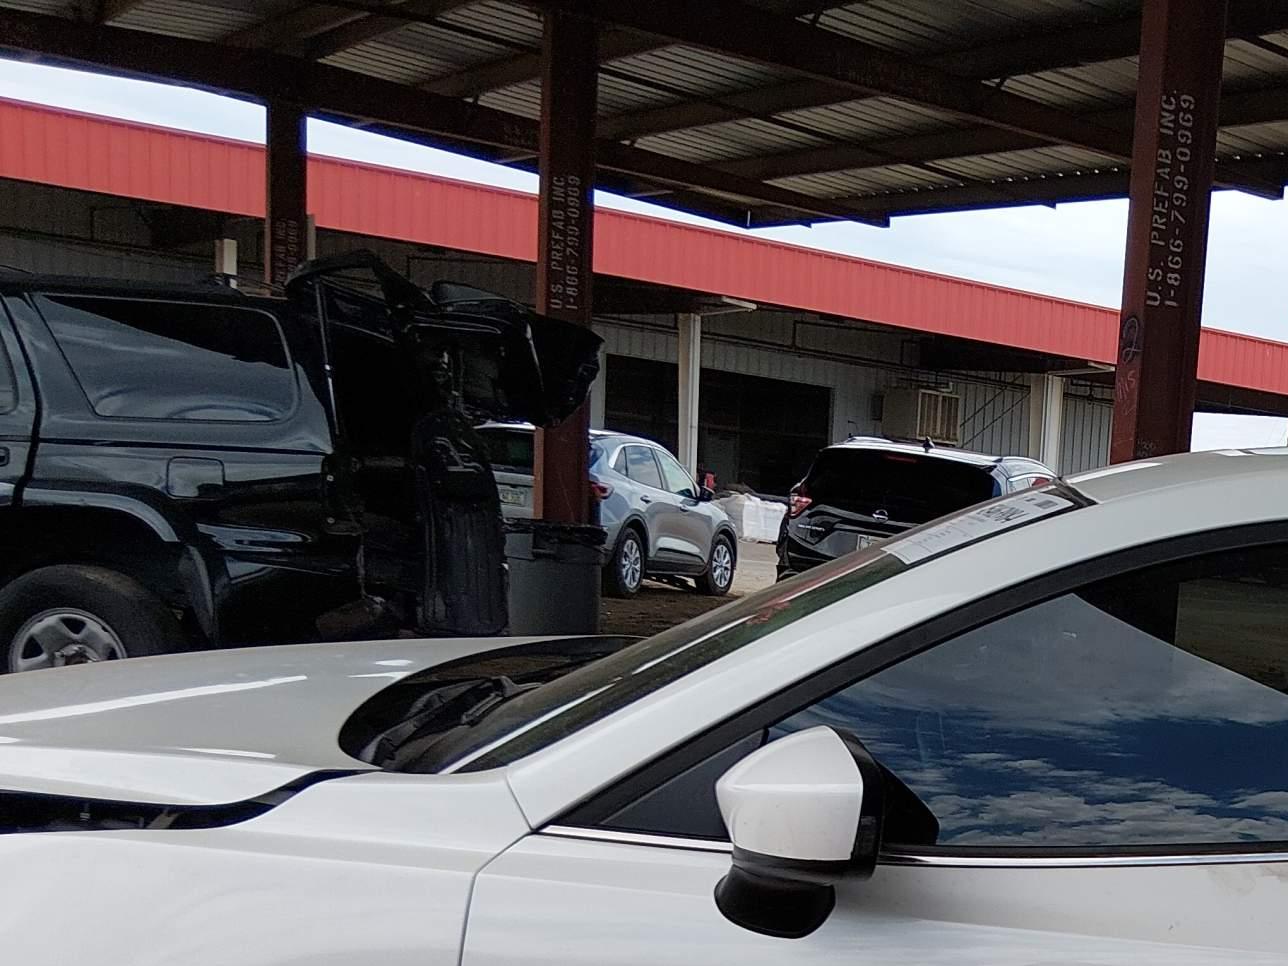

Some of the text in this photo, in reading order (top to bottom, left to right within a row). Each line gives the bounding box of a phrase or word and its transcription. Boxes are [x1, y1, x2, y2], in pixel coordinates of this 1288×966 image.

[551, 209, 565, 271] PREFAB
[1146, 89, 1177, 307] U.S. PREFAB INC.
[1164, 93, 1196, 307] 1-866-799-0969
